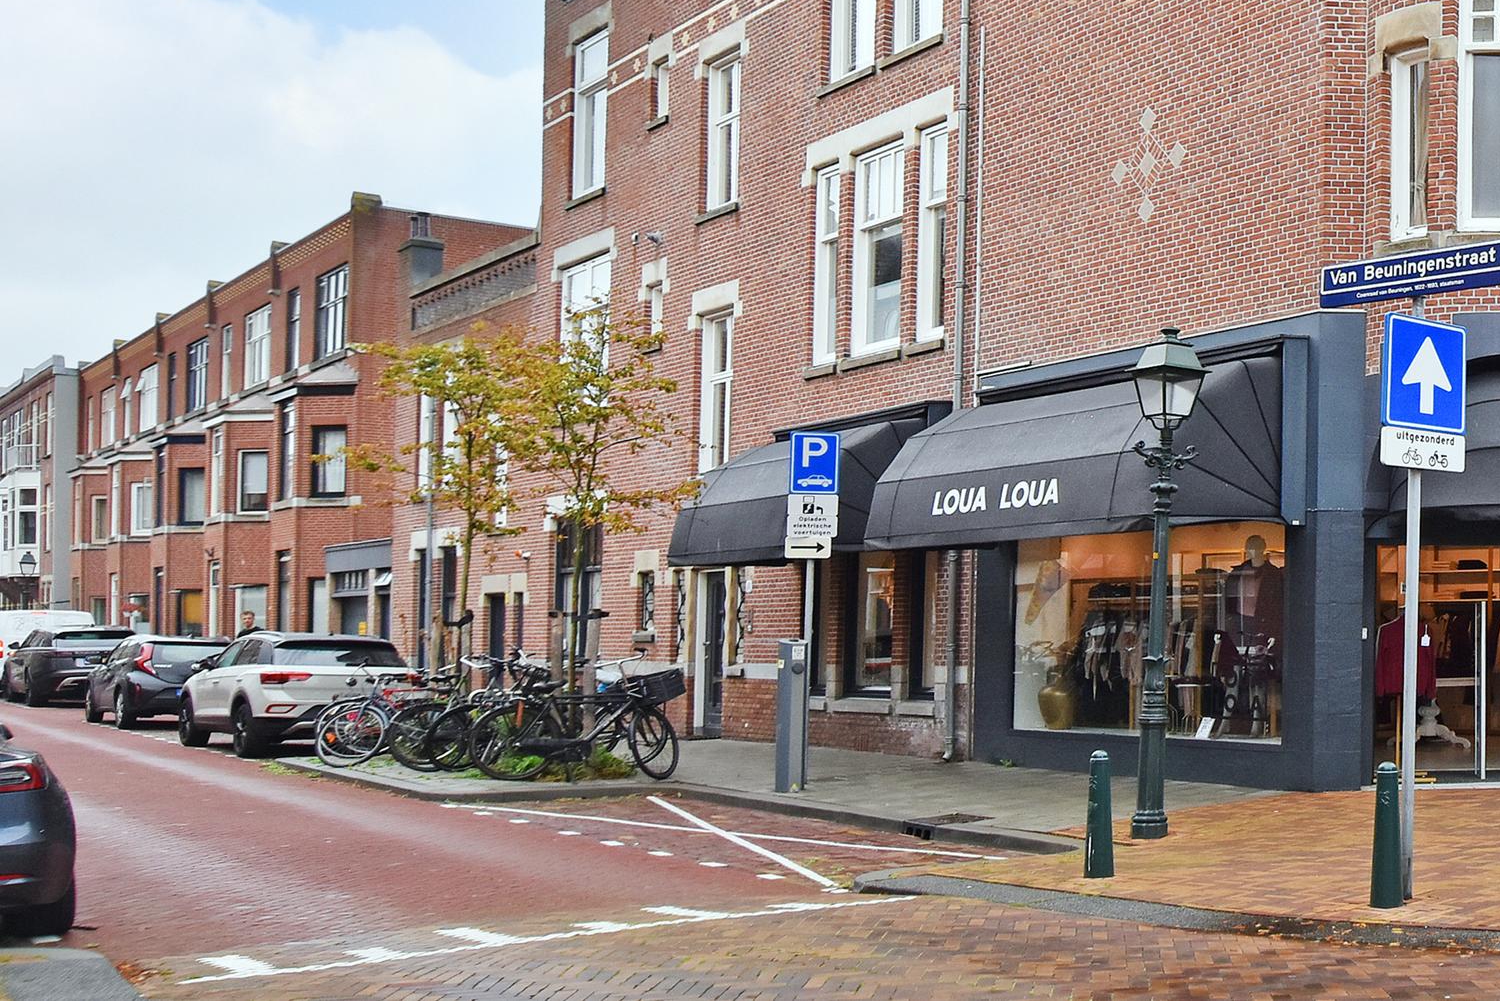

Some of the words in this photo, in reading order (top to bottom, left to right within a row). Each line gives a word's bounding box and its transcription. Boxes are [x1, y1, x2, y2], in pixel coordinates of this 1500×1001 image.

[1330, 270, 1357, 286] Van
[1364, 247, 1497, 281] Beuningenstraat
[1396, 431, 1455, 446] uitgezonderd
[802, 437, 828, 468] P
[931, 486, 987, 516] LOUA
[999, 478, 1059, 509] LOUA
[799, 516, 827, 524] Opladen
[794, 529, 832, 537] voertuigen
